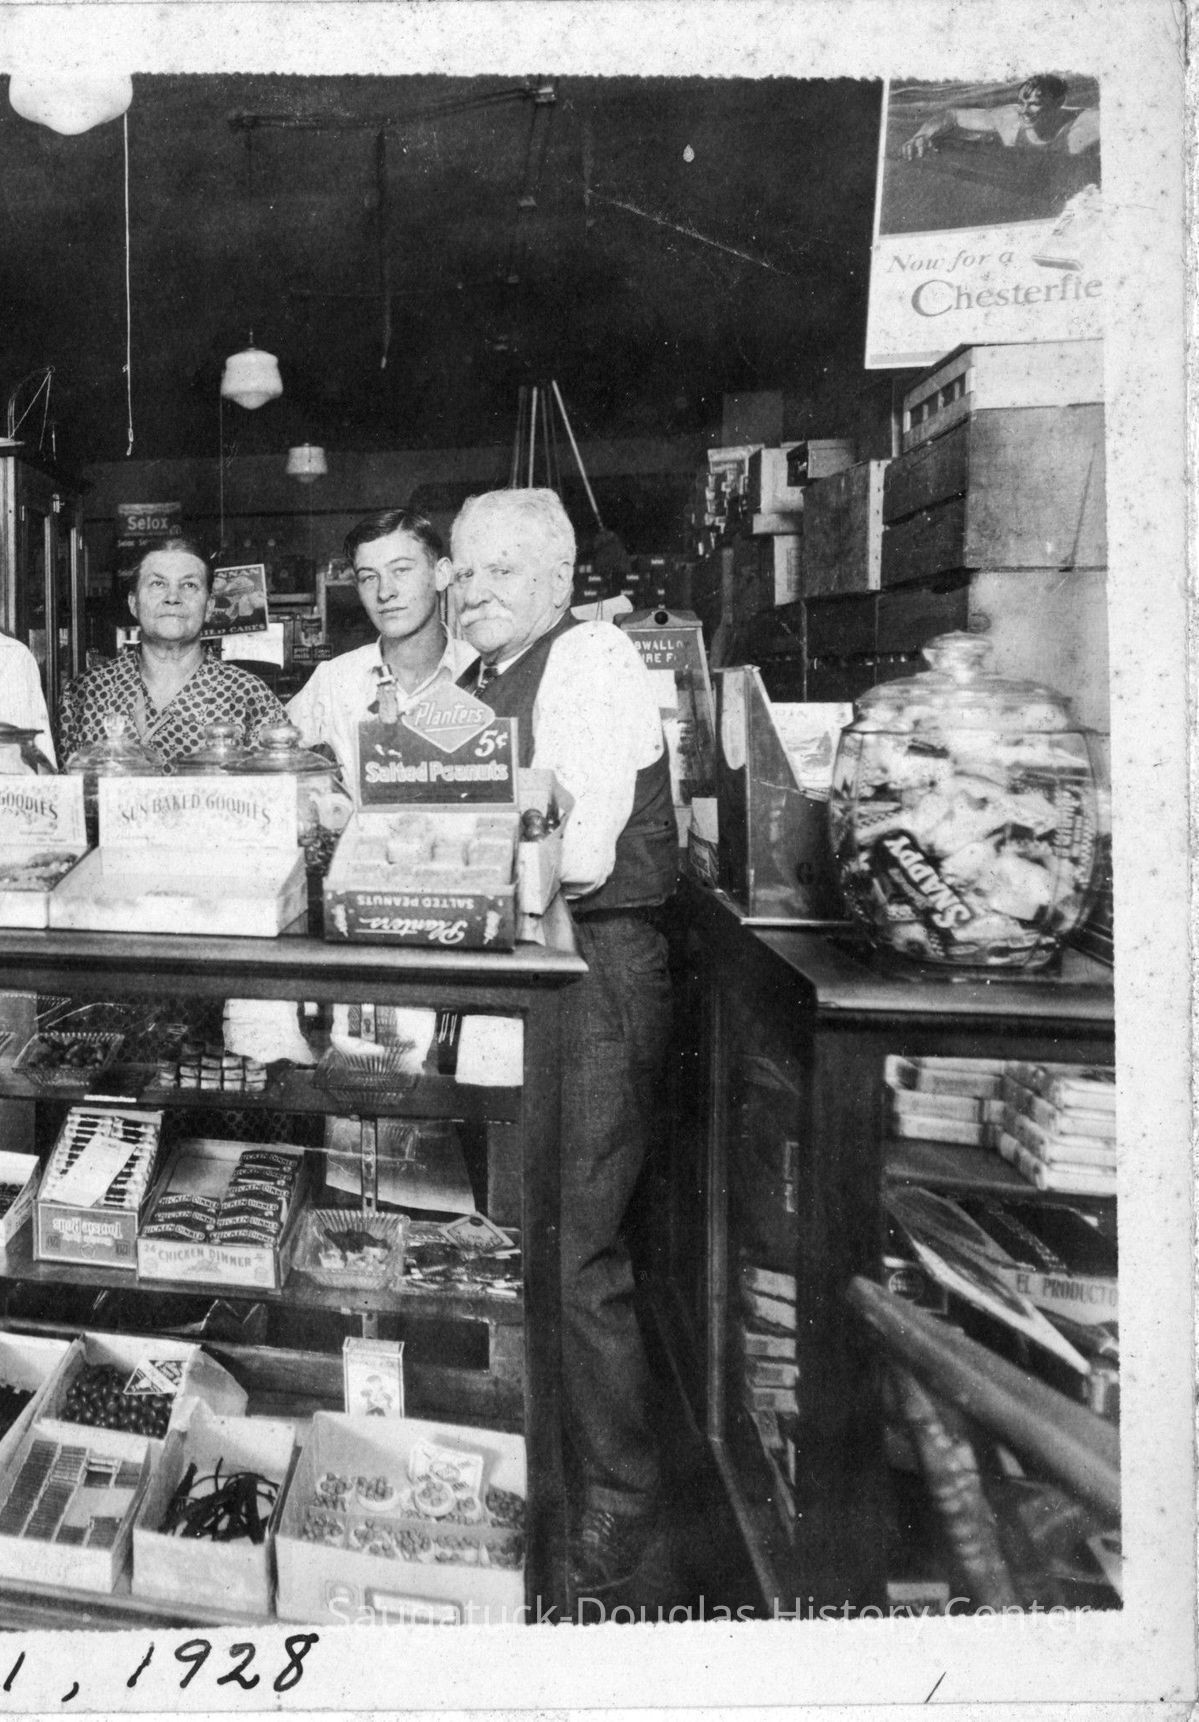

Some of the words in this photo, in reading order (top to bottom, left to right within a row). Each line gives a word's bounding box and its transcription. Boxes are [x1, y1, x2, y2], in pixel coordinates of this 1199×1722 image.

[887, 255, 945, 273] Now
[947, 250, 991, 272] for
[999, 251, 1014, 263] a
[911, 273, 1103, 317] Chesterfie
[127, 516, 169, 531] Selox
[414, 702, 484, 726] Planters
[474, 730, 509, 757] 5¢
[365, 761, 428, 783] Salted
[429, 760, 509, 782] Peanuts
[152, 793, 201, 814] BAKED
[205, 795, 272, 826] GOODIES
[884, 836, 973, 928] SNAPPY
[357, 895, 421, 907] PEANUTS
[423, 898, 475, 909] SALTED
[359, 916, 468, 945] Planters
[158, 1248, 207, 1262] CHICKEN
[208, 1249, 252, 1268] DINNER
[1016, 1274, 1030, 1294] EL
[1042, 1277, 1119, 1306] PRODUCTO
[126, 1634, 319, 1693] 1928
